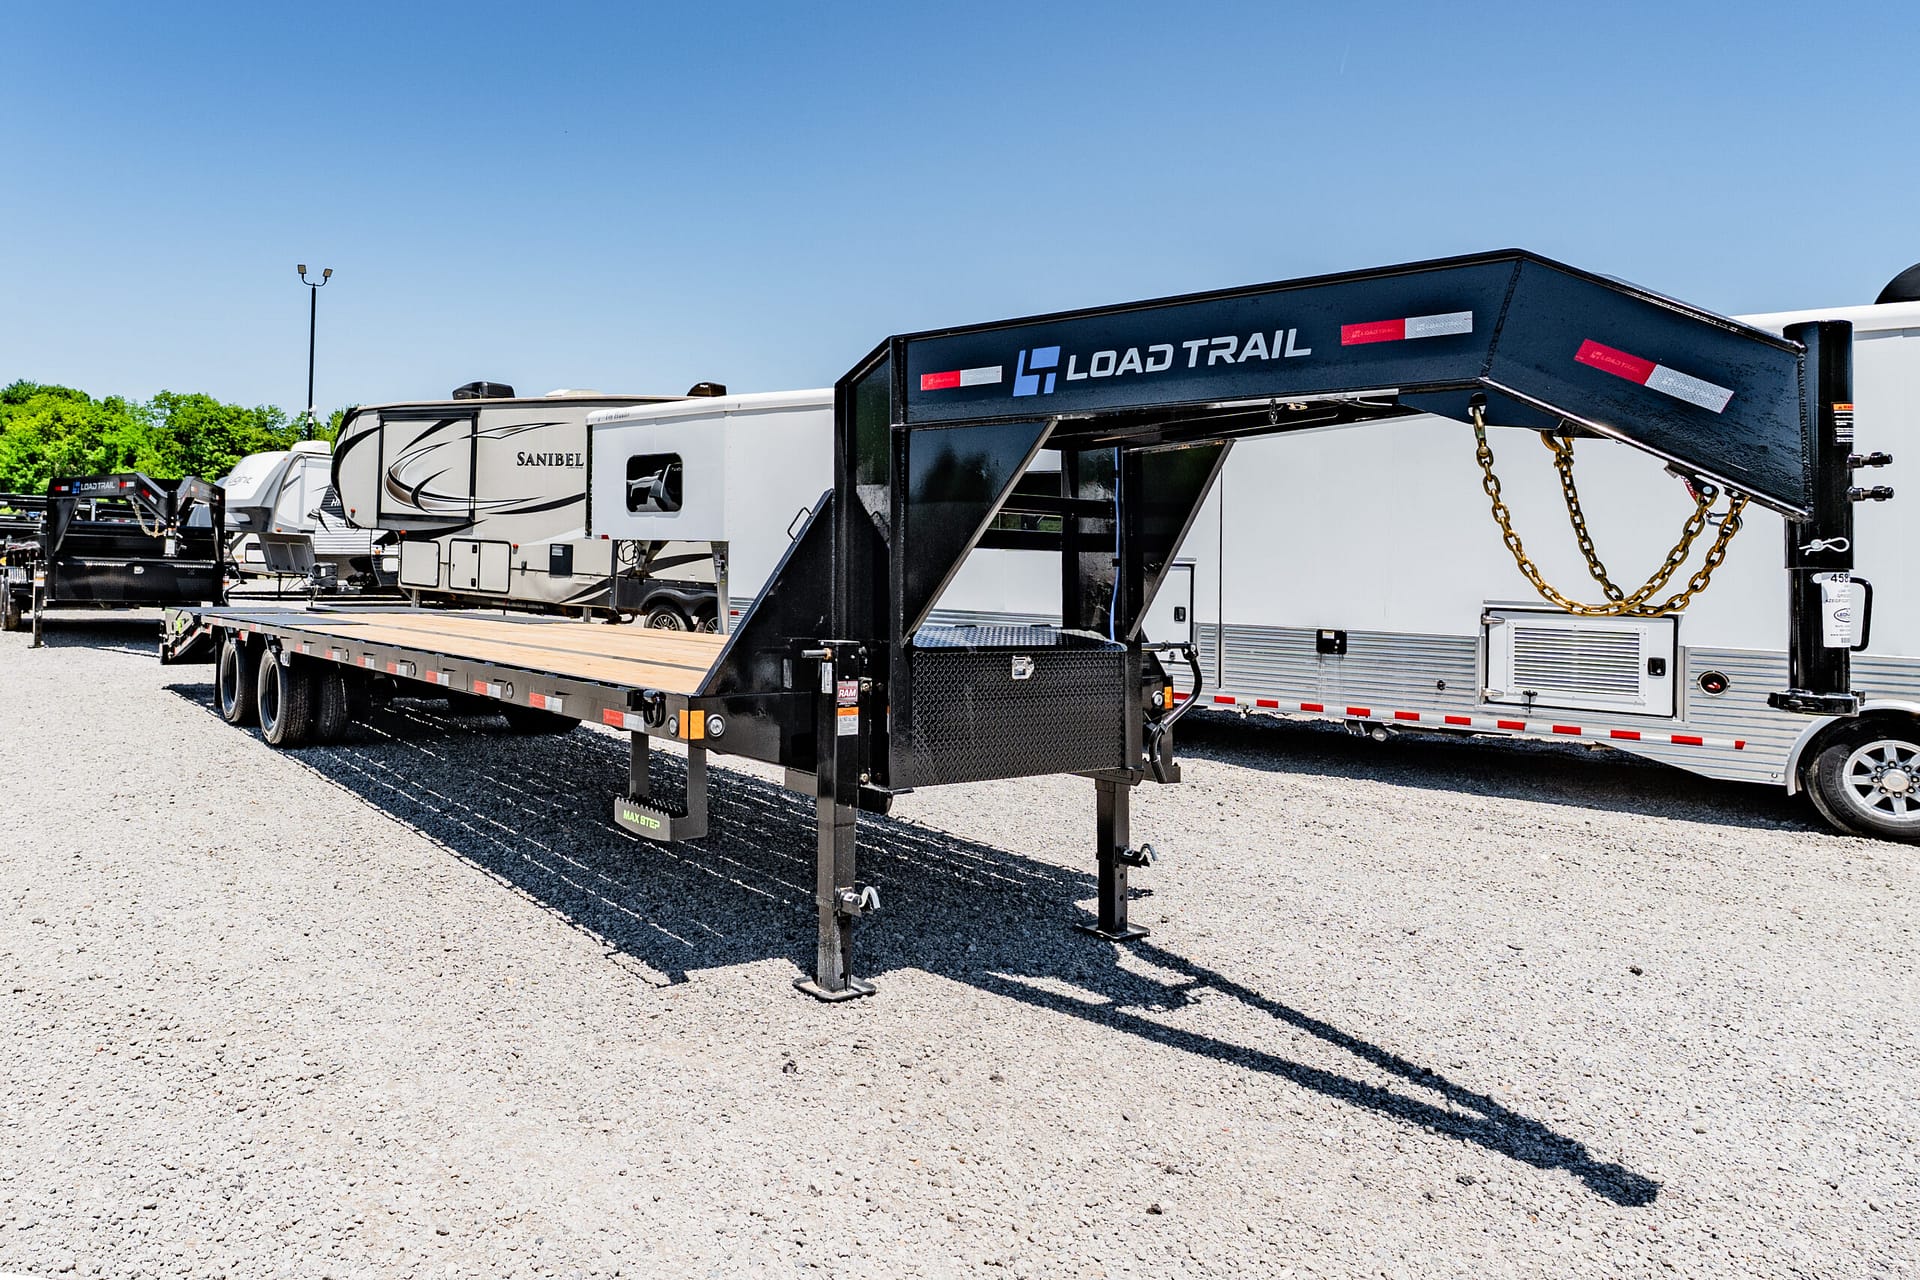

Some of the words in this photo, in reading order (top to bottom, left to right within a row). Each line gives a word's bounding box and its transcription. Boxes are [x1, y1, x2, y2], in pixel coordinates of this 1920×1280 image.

[1066, 343, 1174, 381] LOAD
[1182, 328, 1312, 368] TRAIL
[516, 451, 585, 467] SANIBEL
[80, 483, 97, 491] LOAD
[97, 481, 116, 490] TRAIL
[838, 688, 857, 698] RAM
[623, 809, 640, 825] MAX
[640, 815, 661, 830] STEP
